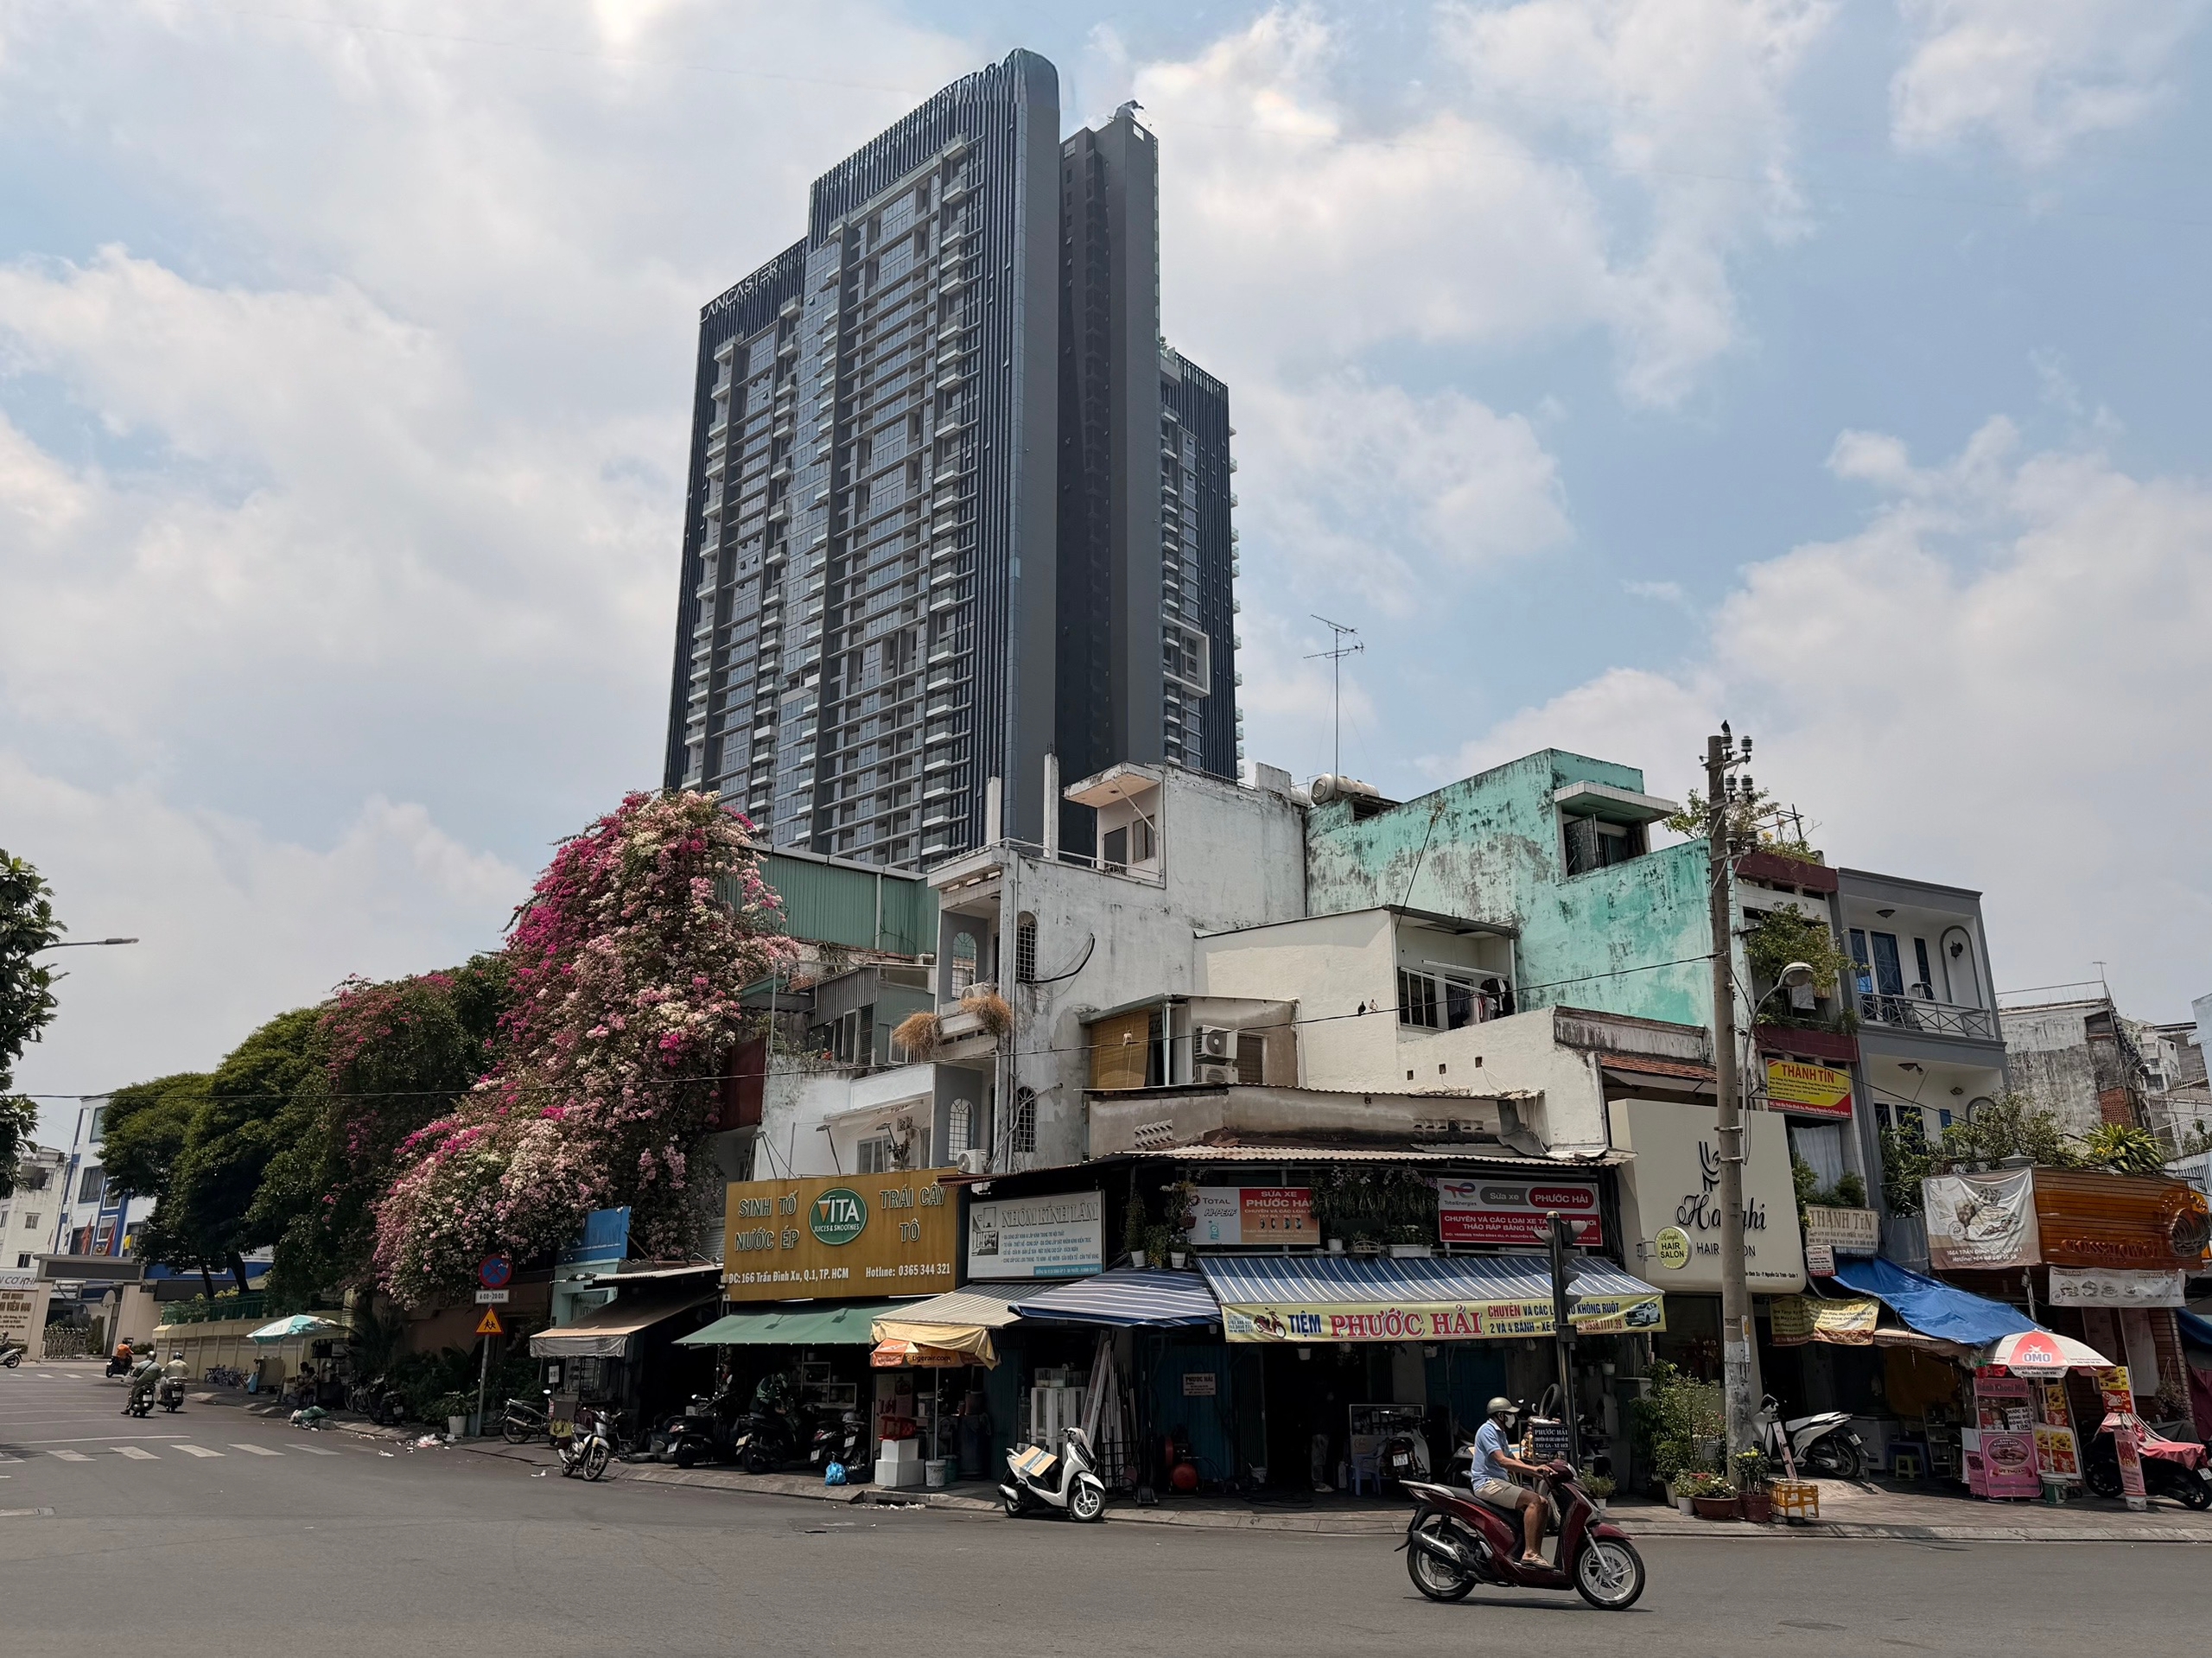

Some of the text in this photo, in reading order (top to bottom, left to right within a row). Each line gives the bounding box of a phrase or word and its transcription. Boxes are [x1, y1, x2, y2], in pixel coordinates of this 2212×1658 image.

[1782, 1064, 1816, 1080] THÀNH
[1818, 1068, 1835, 1083] TÍN
[738, 1190, 798, 1217] SINH TỐ
[880, 1181, 947, 1210] TRÁI CÂY
[1246, 1198, 1289, 1207] PHƯỚC
[1535, 1193, 1569, 1203] PHƯỚC
[1573, 1194, 1588, 1204] HẢI
[817, 1196, 860, 1223] VITA
[1001, 1200, 1098, 1228] NHÔM KÍNH LÂM
[1676, 1194, 1766, 1234] Hahi
[735, 1225, 800, 1251] NƯỚC ÉP
[899, 1218, 920, 1242] TÔ
[1696, 1242, 1719, 1255] HAIR
[742, 1272, 755, 1283] 166
[757, 1271, 772, 1282] Trần
[772, 1270, 790, 1282] Đình
[791, 1270, 803, 1282] Xu,
[804, 1270, 818, 1281] Q.1,
[819, 1268, 830, 1280] TP.
[831, 1267, 849, 1279] HCM
[866, 1263, 950, 1278] Hotline: 0365 344 321
[1488, 1303, 1521, 1318] CHUYÊN
[1534, 1304, 1548, 1316] CÁC
[1578, 1301, 1601, 1314] KHÔNG
[1603, 1302, 1619, 1316] RUỘT
[1287, 1311, 1322, 1337] TIỆM
[1329, 1308, 1425, 1338] PHƯỚC
[1431, 1304, 1484, 1338] HẢI
[1491, 1324, 1495, 1333] 2
[1496, 1322, 1506, 1333] VÀ
[1508, 1323, 1513, 1333] 4
[1514, 1321, 1535, 1333] BÁNH
[1541, 1322, 1551, 1331] XE
[2024, 1353, 2051, 1363] OMO
